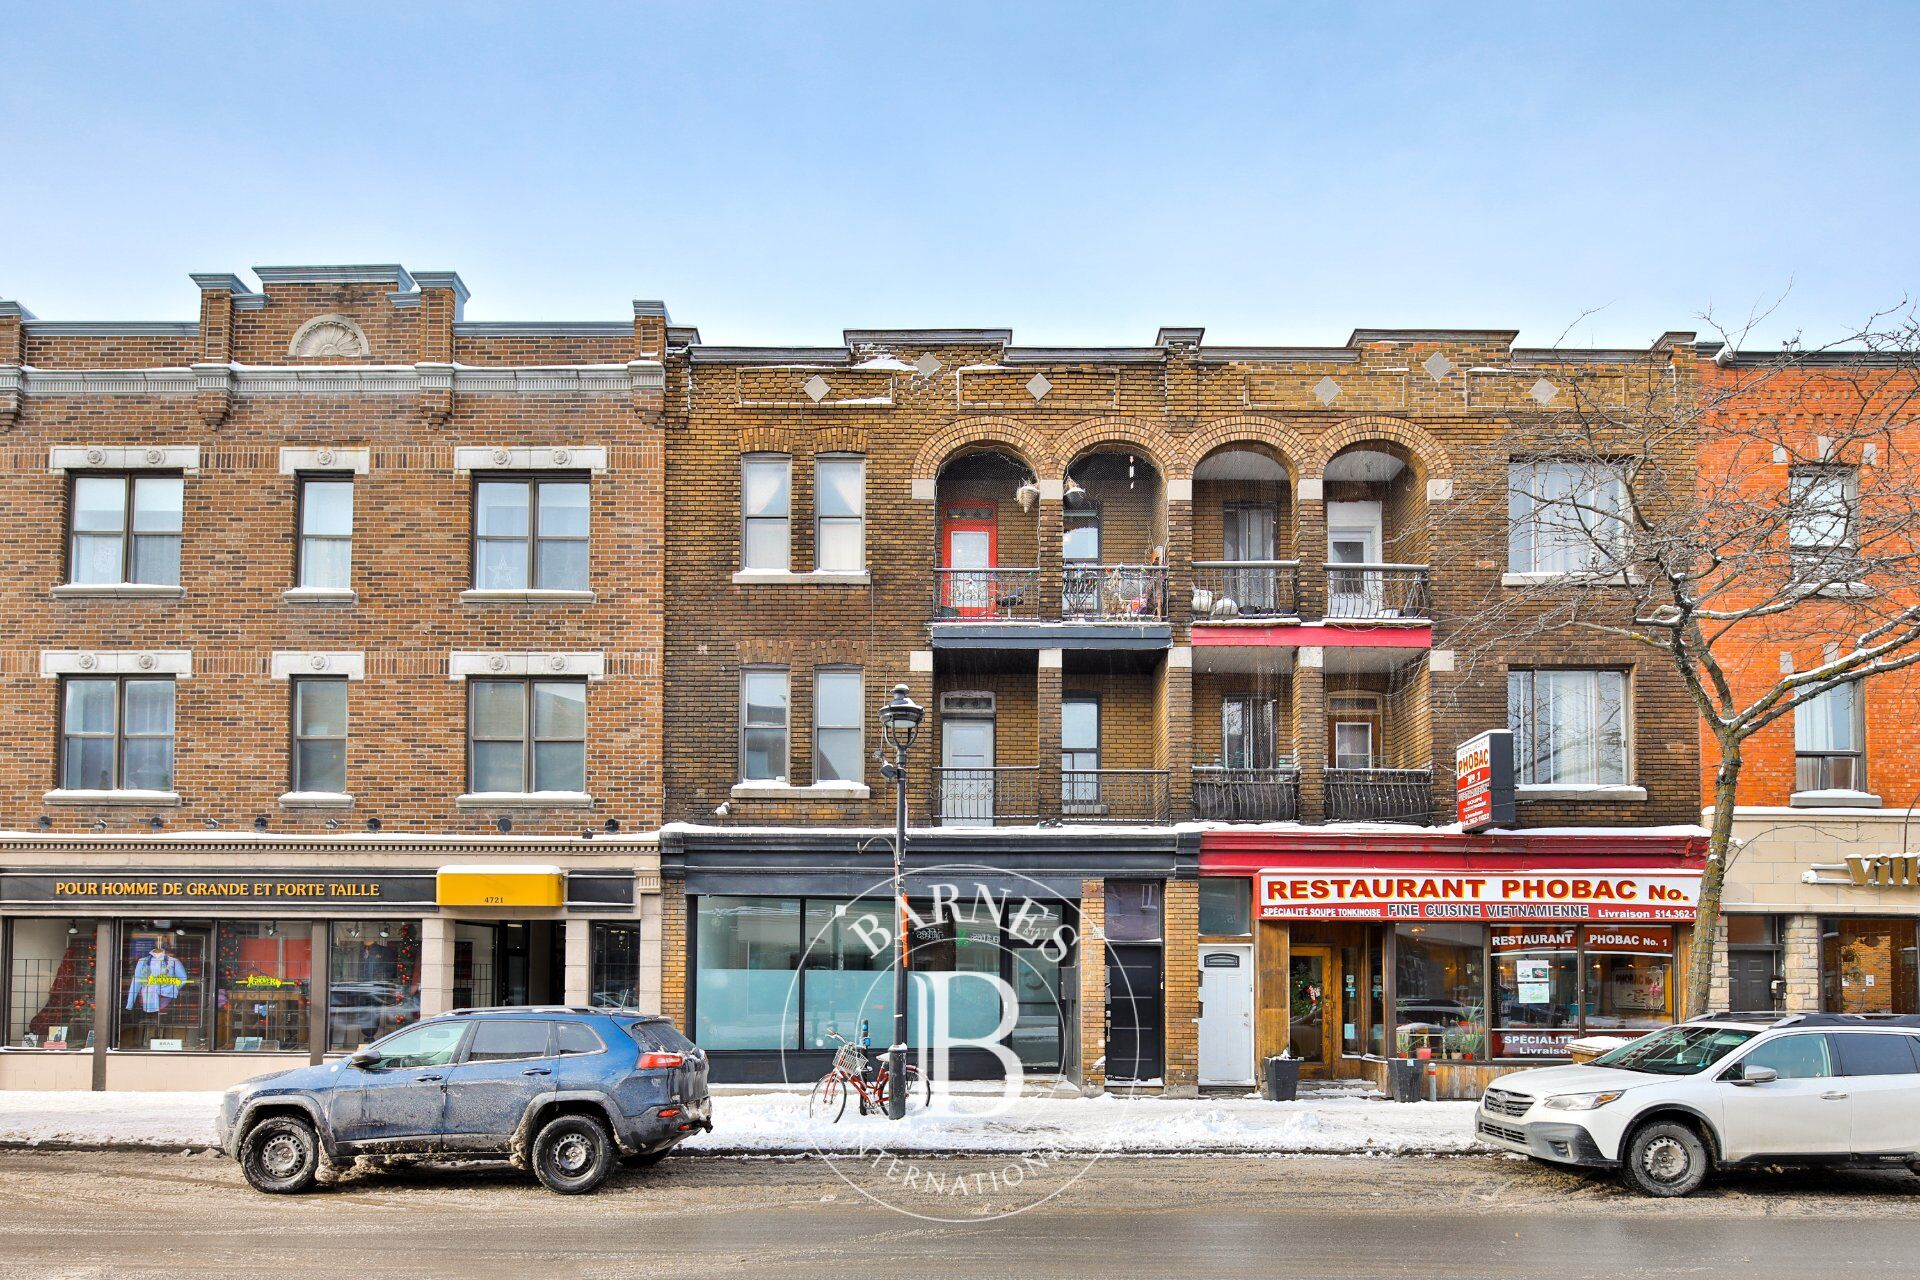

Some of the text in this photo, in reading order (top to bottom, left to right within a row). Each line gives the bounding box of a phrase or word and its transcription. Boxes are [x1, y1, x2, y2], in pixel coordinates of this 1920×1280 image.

[1458, 749, 1488, 775] PHOBAC
[1844, 854, 1920, 886] Vill
[55, 882, 380, 896] POUR HOMME DE GRANDE ET FORTE TAILLE
[1267, 878, 1690, 901] RESTAURANT PHOBAC No.
[484, 896, 504, 904] 4721
[1263, 904, 1698, 919] SPÉCIALITÉ SOUPE TONKINOISE FINE CUISINE VIETNAMIENNE Livraison 514.362-1
[1022, 927, 1048, 937] 4717
[1492, 933, 1668, 947] RESTAURANT PHOBAC No. 1
